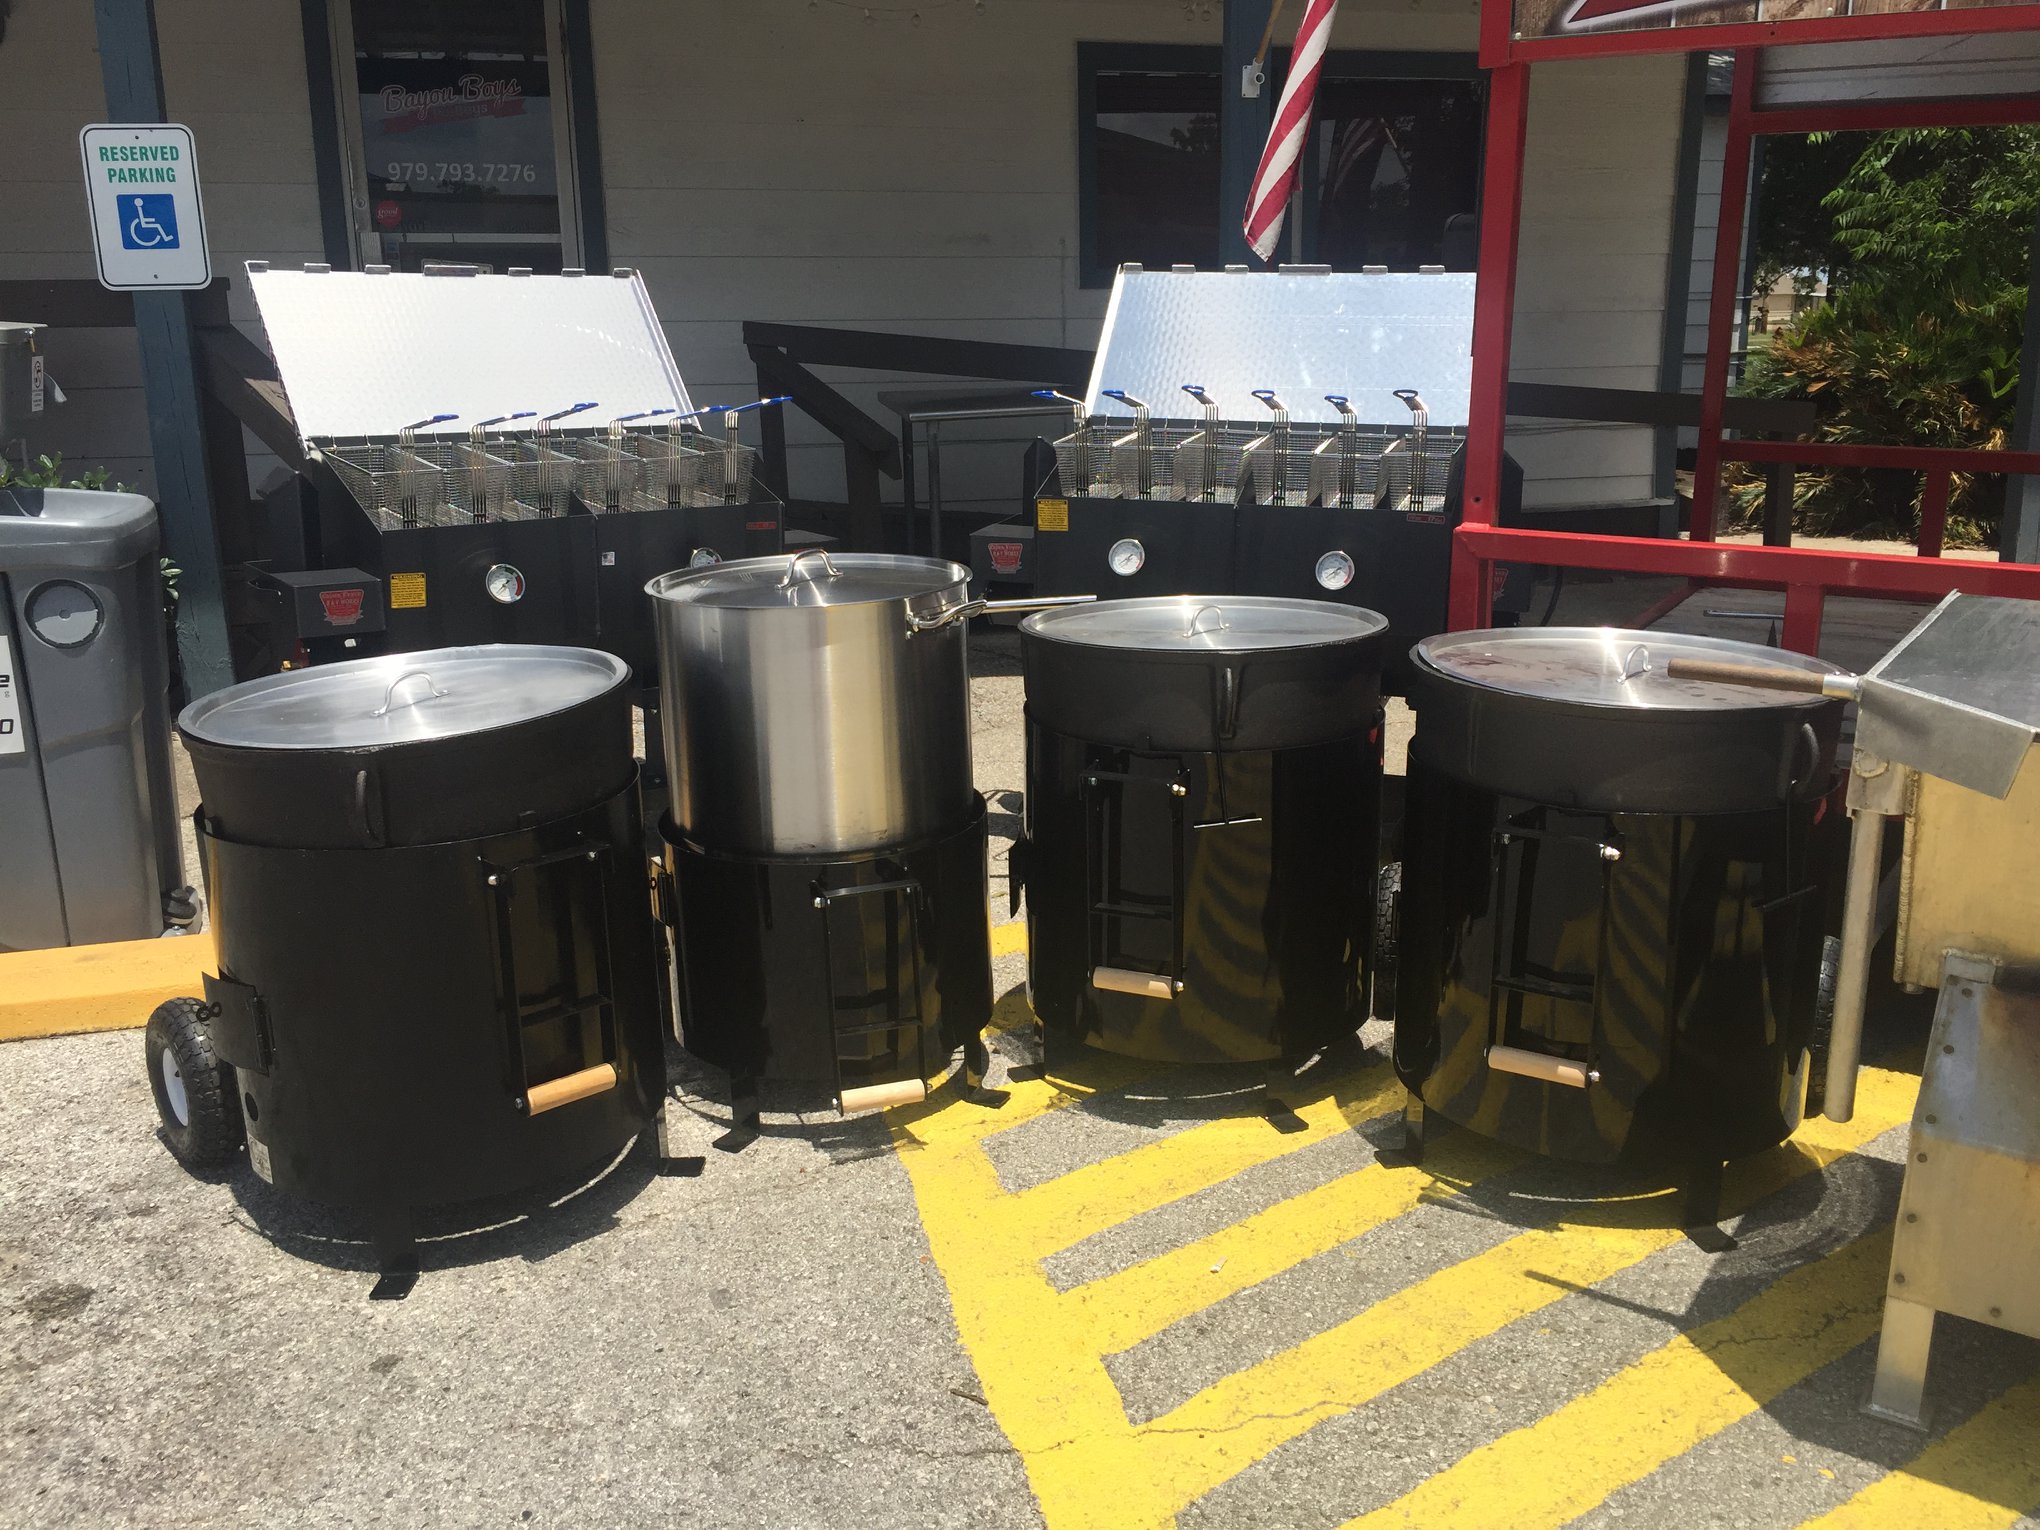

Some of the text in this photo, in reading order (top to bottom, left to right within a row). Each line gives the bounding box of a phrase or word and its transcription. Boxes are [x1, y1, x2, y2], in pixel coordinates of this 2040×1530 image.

[379, 84, 457, 120] Bayou
[458, 73, 522, 106] Boys
[98, 145, 180, 161] RESERVED
[107, 167, 177, 183] PARKING
[387, 161, 537, 183] 979.793.7276
